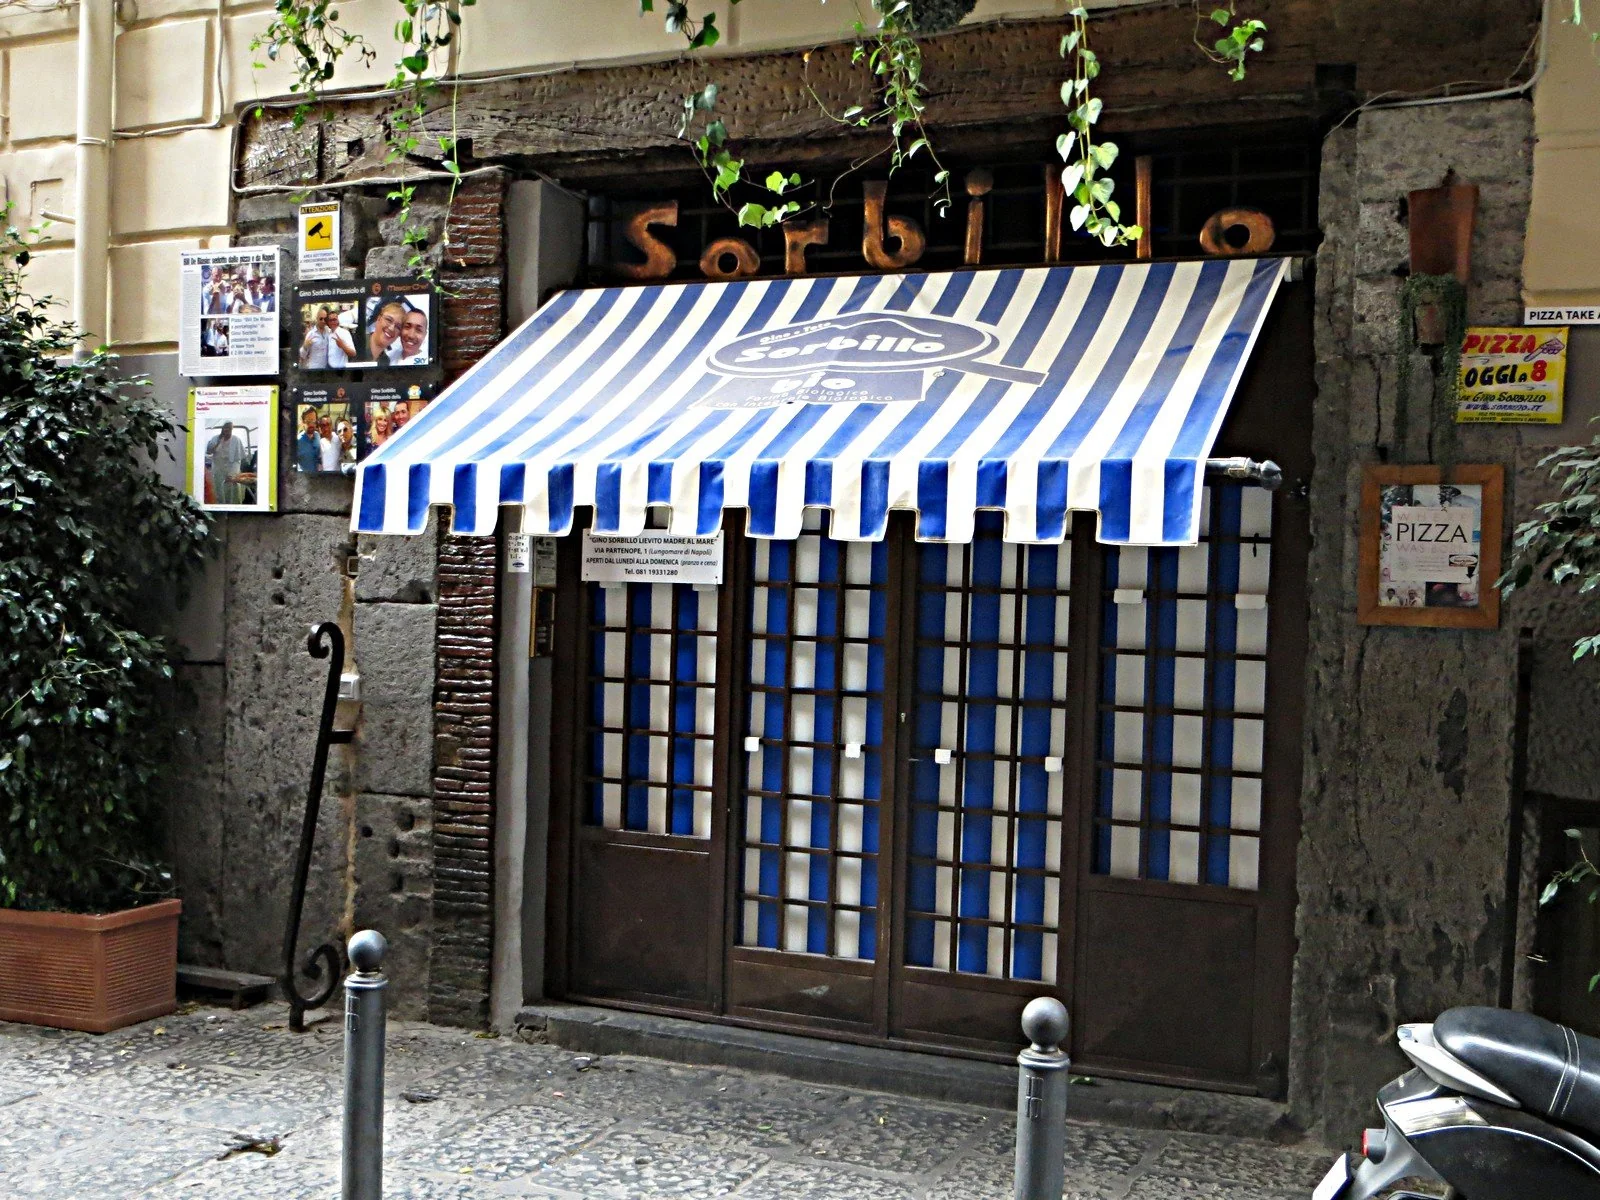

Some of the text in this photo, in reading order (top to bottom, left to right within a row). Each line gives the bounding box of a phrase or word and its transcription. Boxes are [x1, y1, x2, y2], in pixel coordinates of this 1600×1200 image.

[621, 155, 1276, 279] Sorbillo
[1530, 311, 1563, 320] PIZZA
[1566, 310, 1595, 320] TAKE
[760, 332, 791, 344] Gino
[1462, 334, 1537, 354] PIZZA
[734, 334, 945, 363] Sorbillo
[770, 371, 857, 393] bio
[1464, 364, 1518, 388] OGGI
[1530, 360, 1547, 381] 8
[1396, 522, 1468, 543] PIZZA
[648, 548, 684, 556] (Lungomare
[1395, 543, 1424, 553] WAS
